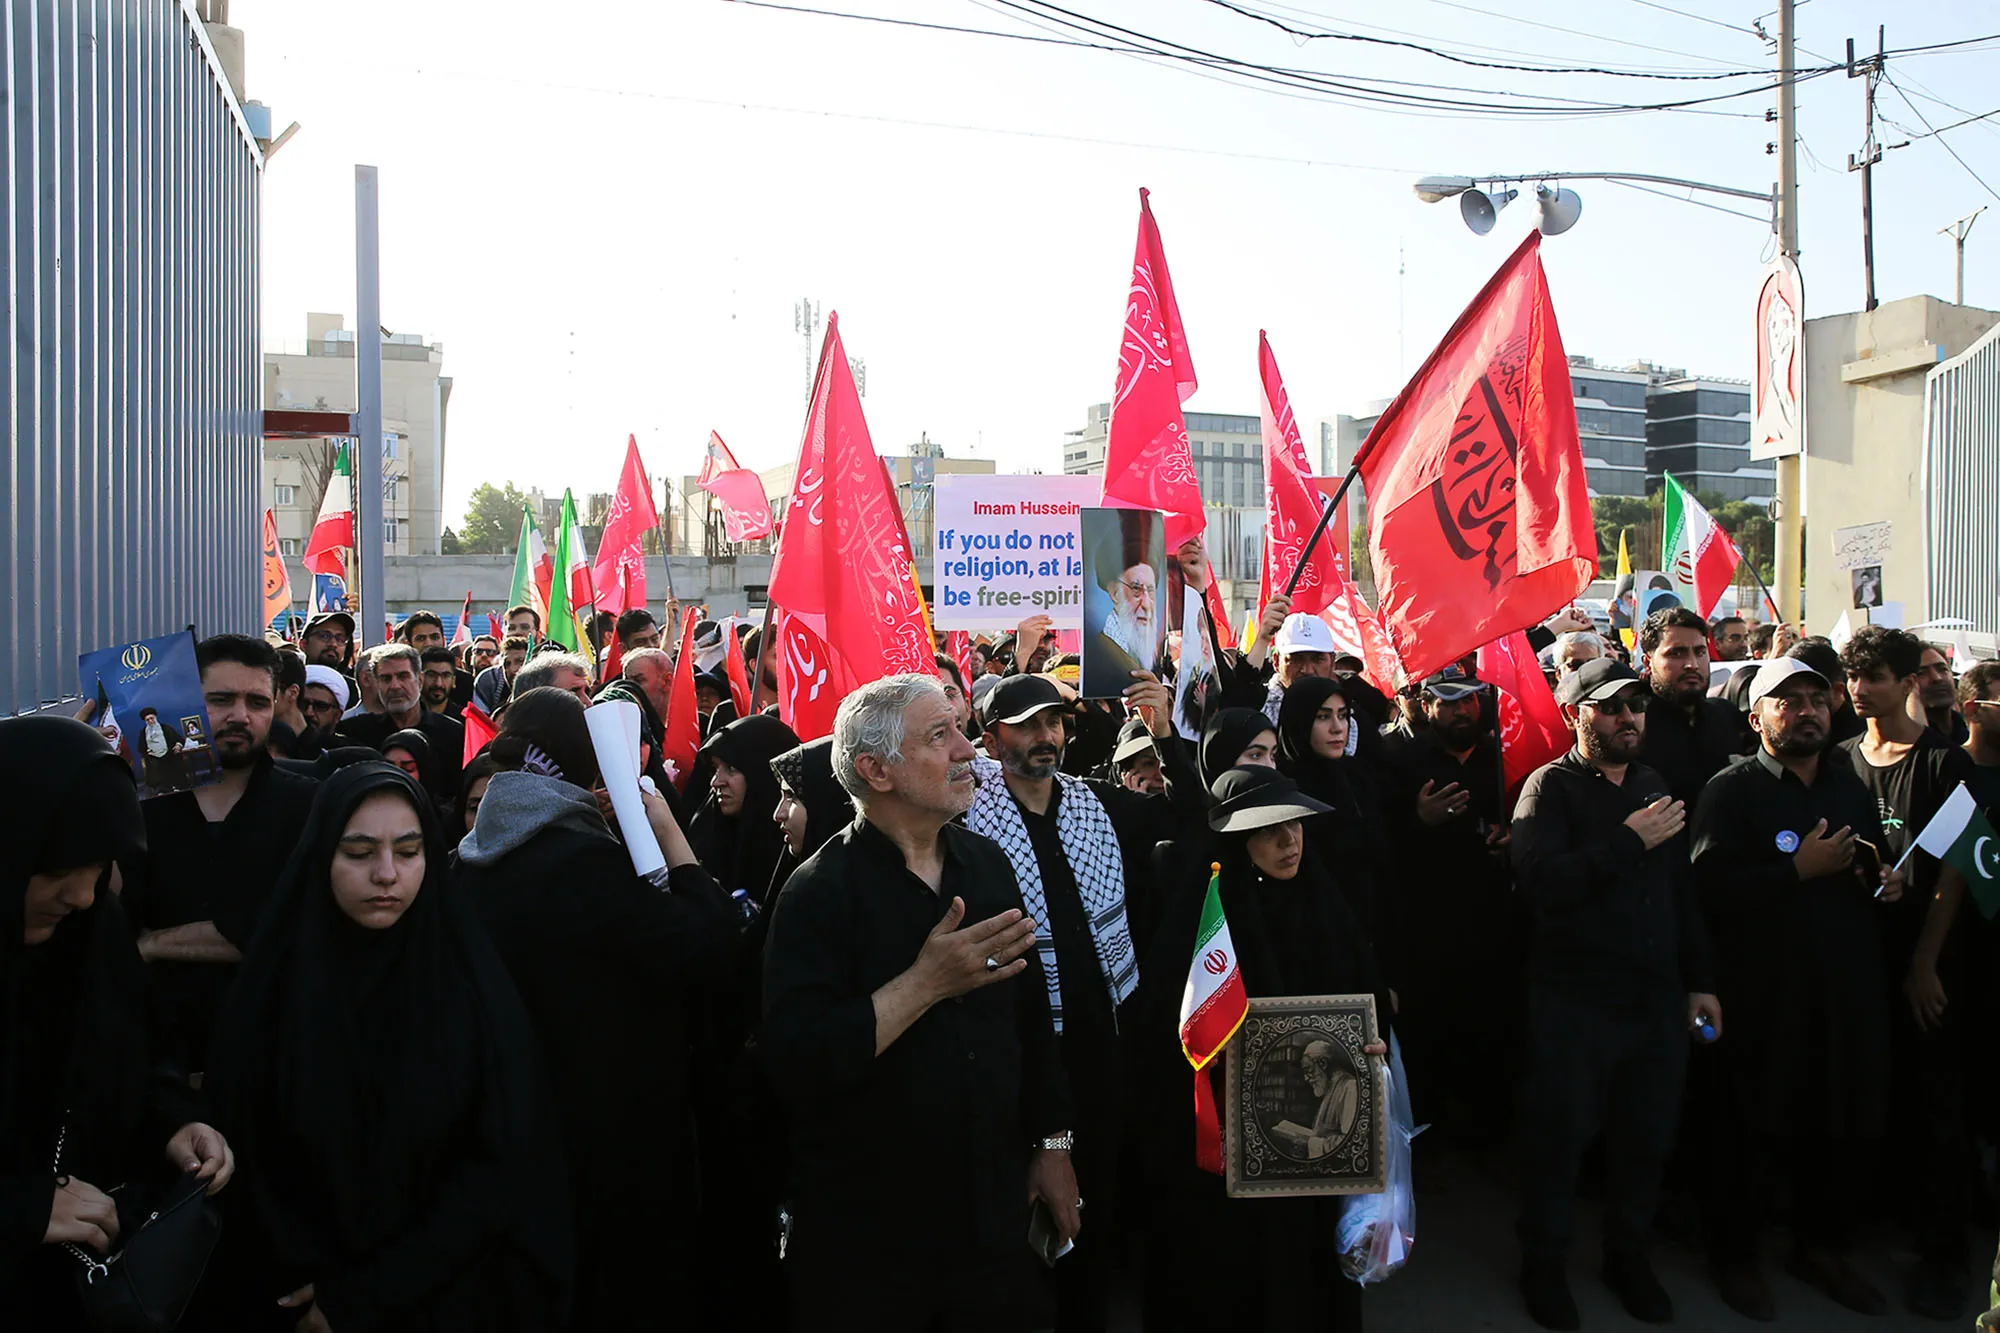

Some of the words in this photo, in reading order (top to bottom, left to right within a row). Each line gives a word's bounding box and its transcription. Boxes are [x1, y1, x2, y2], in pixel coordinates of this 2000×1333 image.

[973, 501, 1016, 515] Imam
[1020, 501, 1081, 515] Hussein
[938, 529, 955, 549] If
[960, 534, 1000, 555] you
[1005, 529, 1032, 549] do
[1039, 532, 1075, 549] not
[944, 556, 1034, 581] religion,
[1038, 558, 1060, 576] at
[943, 585, 971, 606] be
[977, 585, 1082, 610] free-spiri
